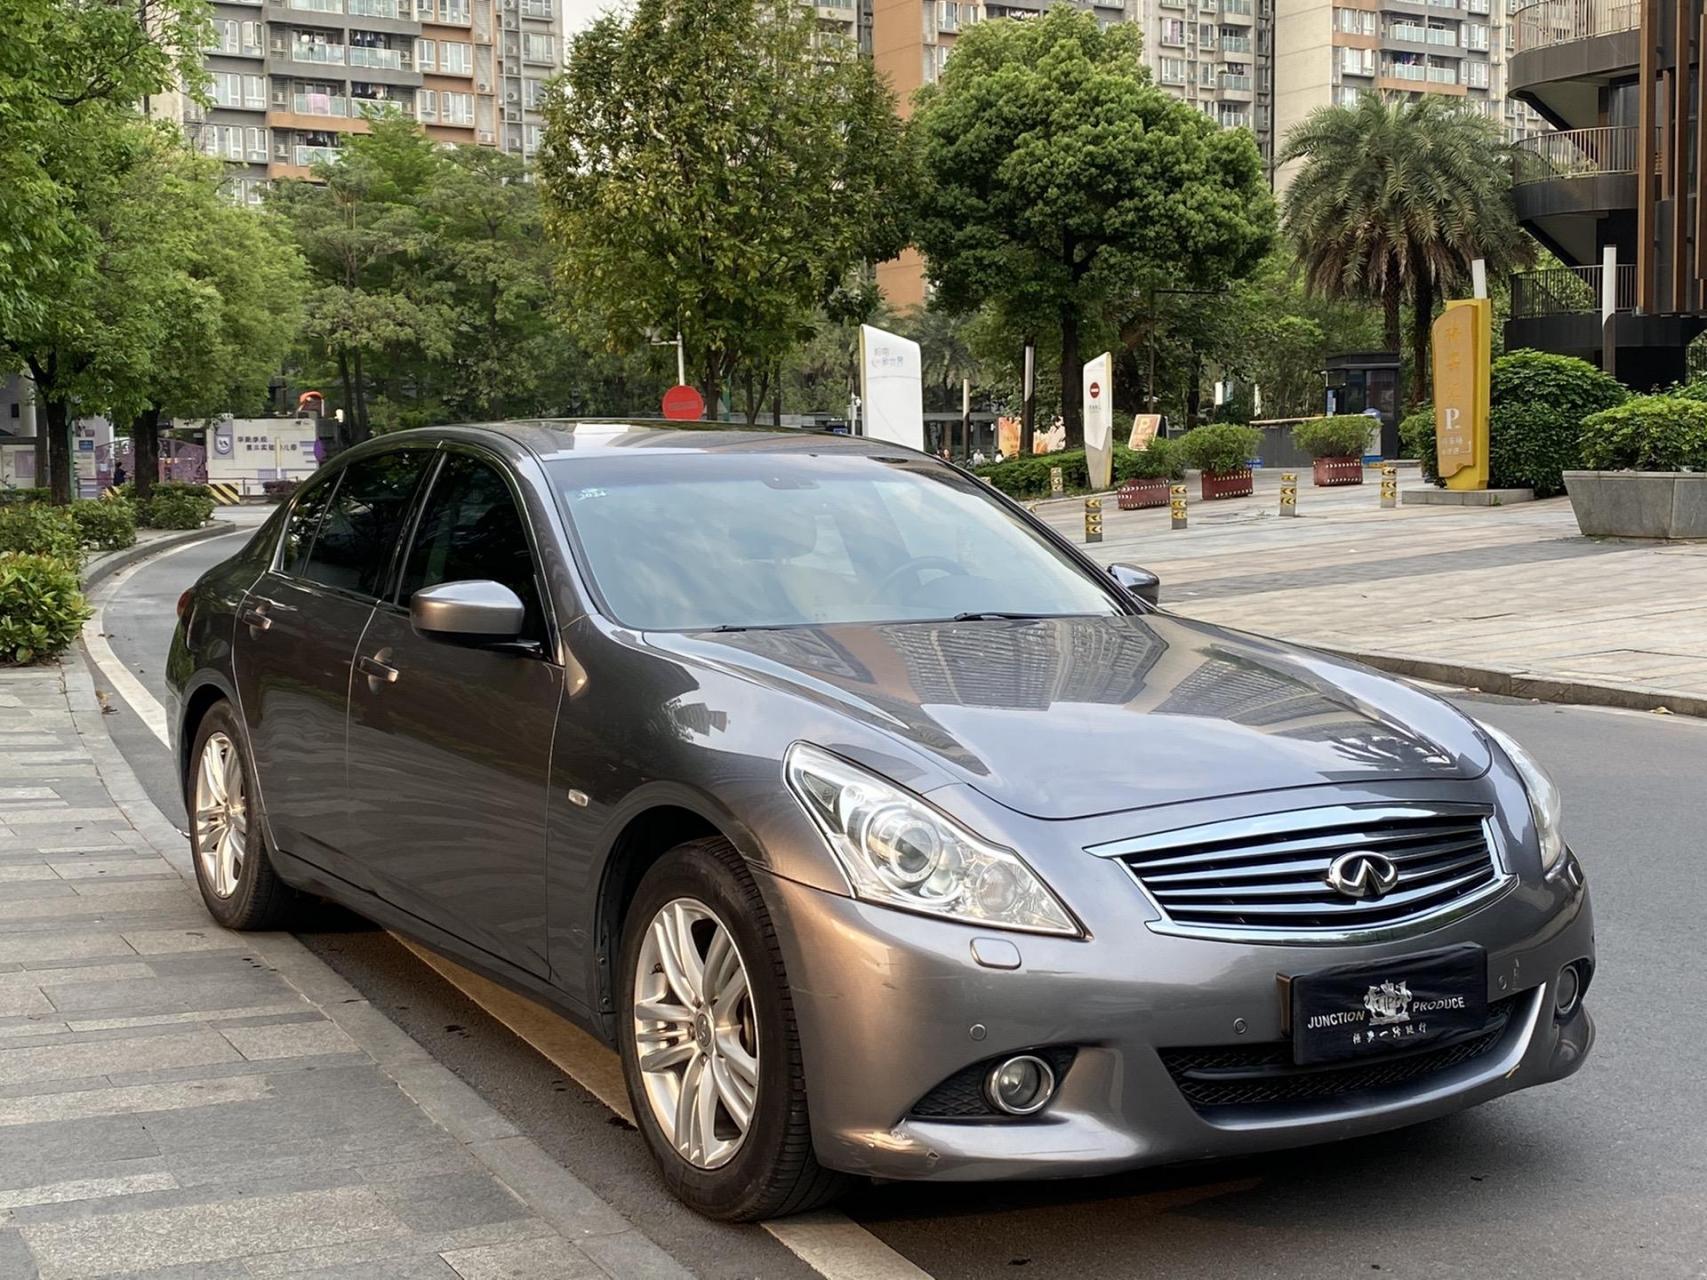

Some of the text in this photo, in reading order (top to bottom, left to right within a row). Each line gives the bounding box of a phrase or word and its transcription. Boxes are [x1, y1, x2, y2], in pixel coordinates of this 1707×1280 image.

[1444, 408, 1460, 430] P
[1307, 1010, 1366, 1029] JUNCTION
[1412, 996, 1466, 1013] PRODUCE
